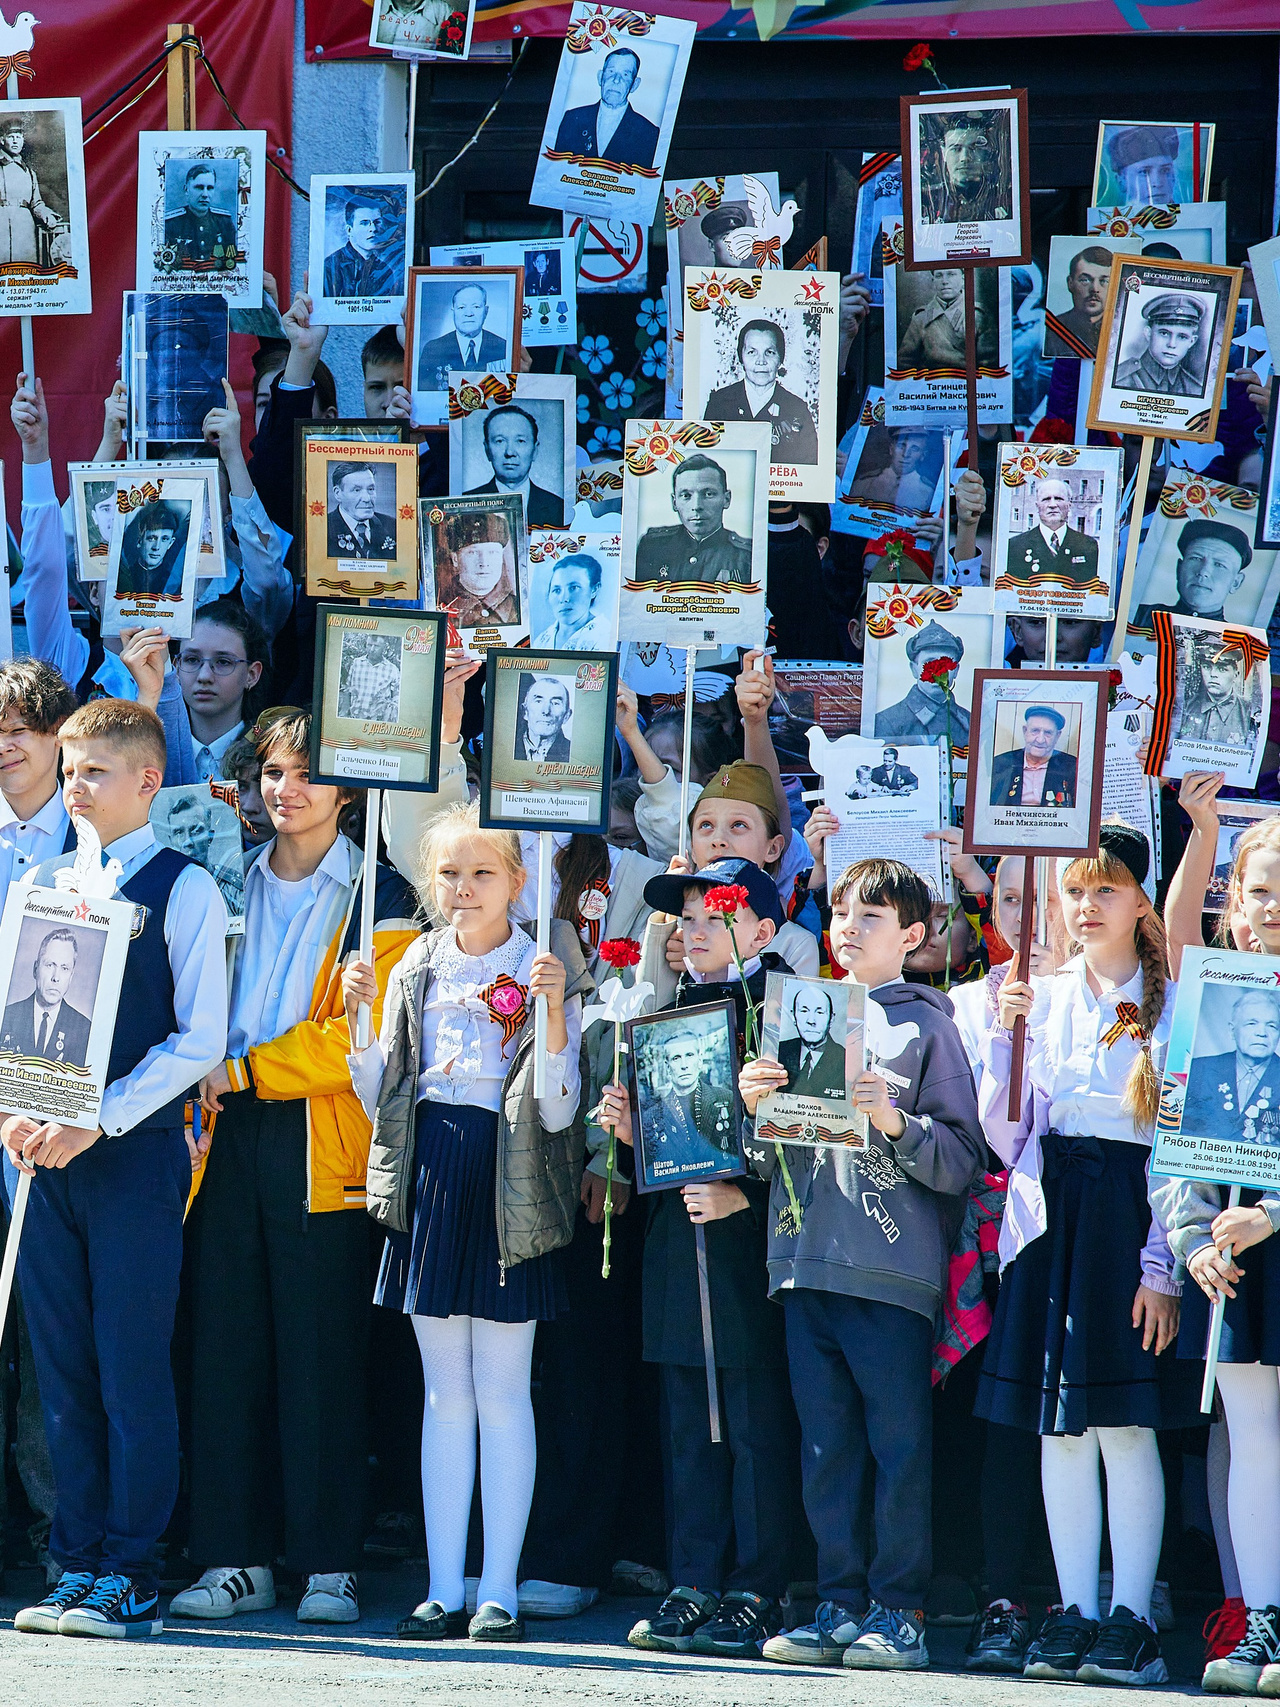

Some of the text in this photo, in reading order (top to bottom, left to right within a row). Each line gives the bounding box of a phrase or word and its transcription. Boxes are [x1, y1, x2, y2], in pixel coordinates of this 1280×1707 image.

[580, 169, 618, 184] Фалалеев
[560, 174, 635, 195] Алексей Андреевич
[583, 189, 606, 198] рядовой
[7, 277, 59, 287] Михайлович
[1143, 272, 1211, 285] БЕССМЕРТНЫЙ ПОЛК
[898, 391, 997, 401] Василий Максиович
[1137, 396, 1174, 406] ИГНАТЬЕВ
[891, 404, 925, 412] 1926-1943
[988, 404, 1005, 412] дуге
[1120, 401, 1189, 415] Дмитрий Сергеевич
[308, 443, 387, 456] Бессмертный
[442, 501, 486, 509] БЕССМЕРТНЫЙ
[1017, 589, 1086, 600] ФЕДОТОВСКИХ
[662, 595, 724, 606] Поскрёбышев
[1046, 599, 1083, 607] Иванович
[120, 609, 139, 617] Сергей
[646, 604, 740, 615] Григорий Семёнович
[328, 616, 379, 630] МЫ ПОМНИМ!
[497, 658, 550, 672] МЫ ПОМНИМ!
[784, 673, 842, 683] Сащенко Павел
[1173, 739, 1253, 757] Орлов Илья Васильевич
[336, 754, 399, 768] Гальченко Иван
[1181, 755, 1239, 769] старший сержант
[343, 766, 390, 779] Степанович
[505, 795, 588, 807] Шевченко Афанасий
[522, 806, 569, 817] Васильевич
[1005, 810, 1058, 819] Немчинский
[994, 817, 1069, 828] Иван Михайлович
[15, 1068, 42, 1083] Иван
[42, 1073, 97, 1094] Матвеевич
[797, 1103, 822, 1111] ВОЛКОВ
[773, 1107, 848, 1121] ВЛАДИМИР АЛЕКСЕЕВИЧ
[1163, 1135, 1280, 1161] Рябов Павел Никифо
[653, 1160, 675, 1170] Шатов
[653, 1160, 715, 1178] Василий Яковлевич
[1155, 1158, 1245, 1177] Звание: старший сержант
